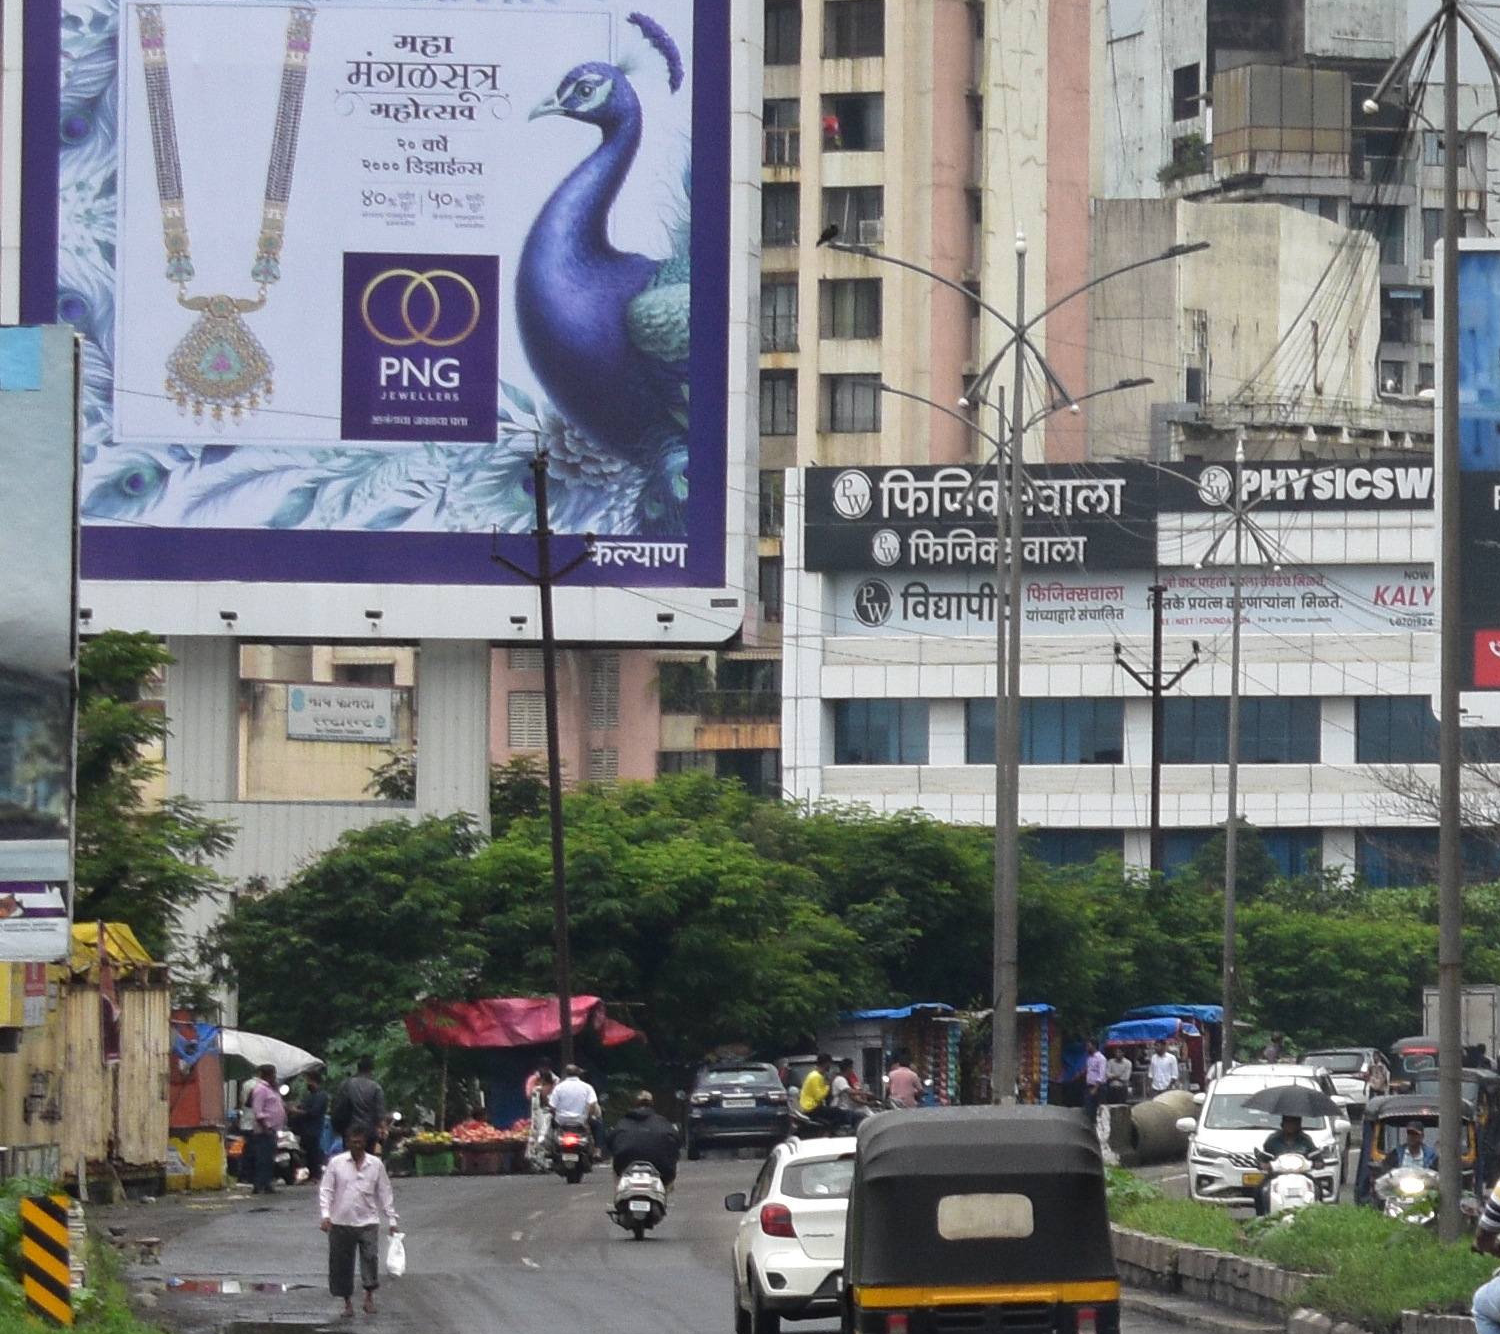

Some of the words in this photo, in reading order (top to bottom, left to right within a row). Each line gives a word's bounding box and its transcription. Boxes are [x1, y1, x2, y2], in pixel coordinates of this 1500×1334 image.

[393, 34, 454, 59] महा
[346, 50, 502, 103] मंगळसूत्र
[369, 96, 477, 124] महोत्सव
[397, 137, 416, 152] २०
[362, 158, 400, 173] २०००
[380, 356, 460, 388] PNG
[380, 391, 460, 402] JEWELLERS
[589, 541, 689, 568] कल्याण
[1403, 570, 1428, 580] NOW
